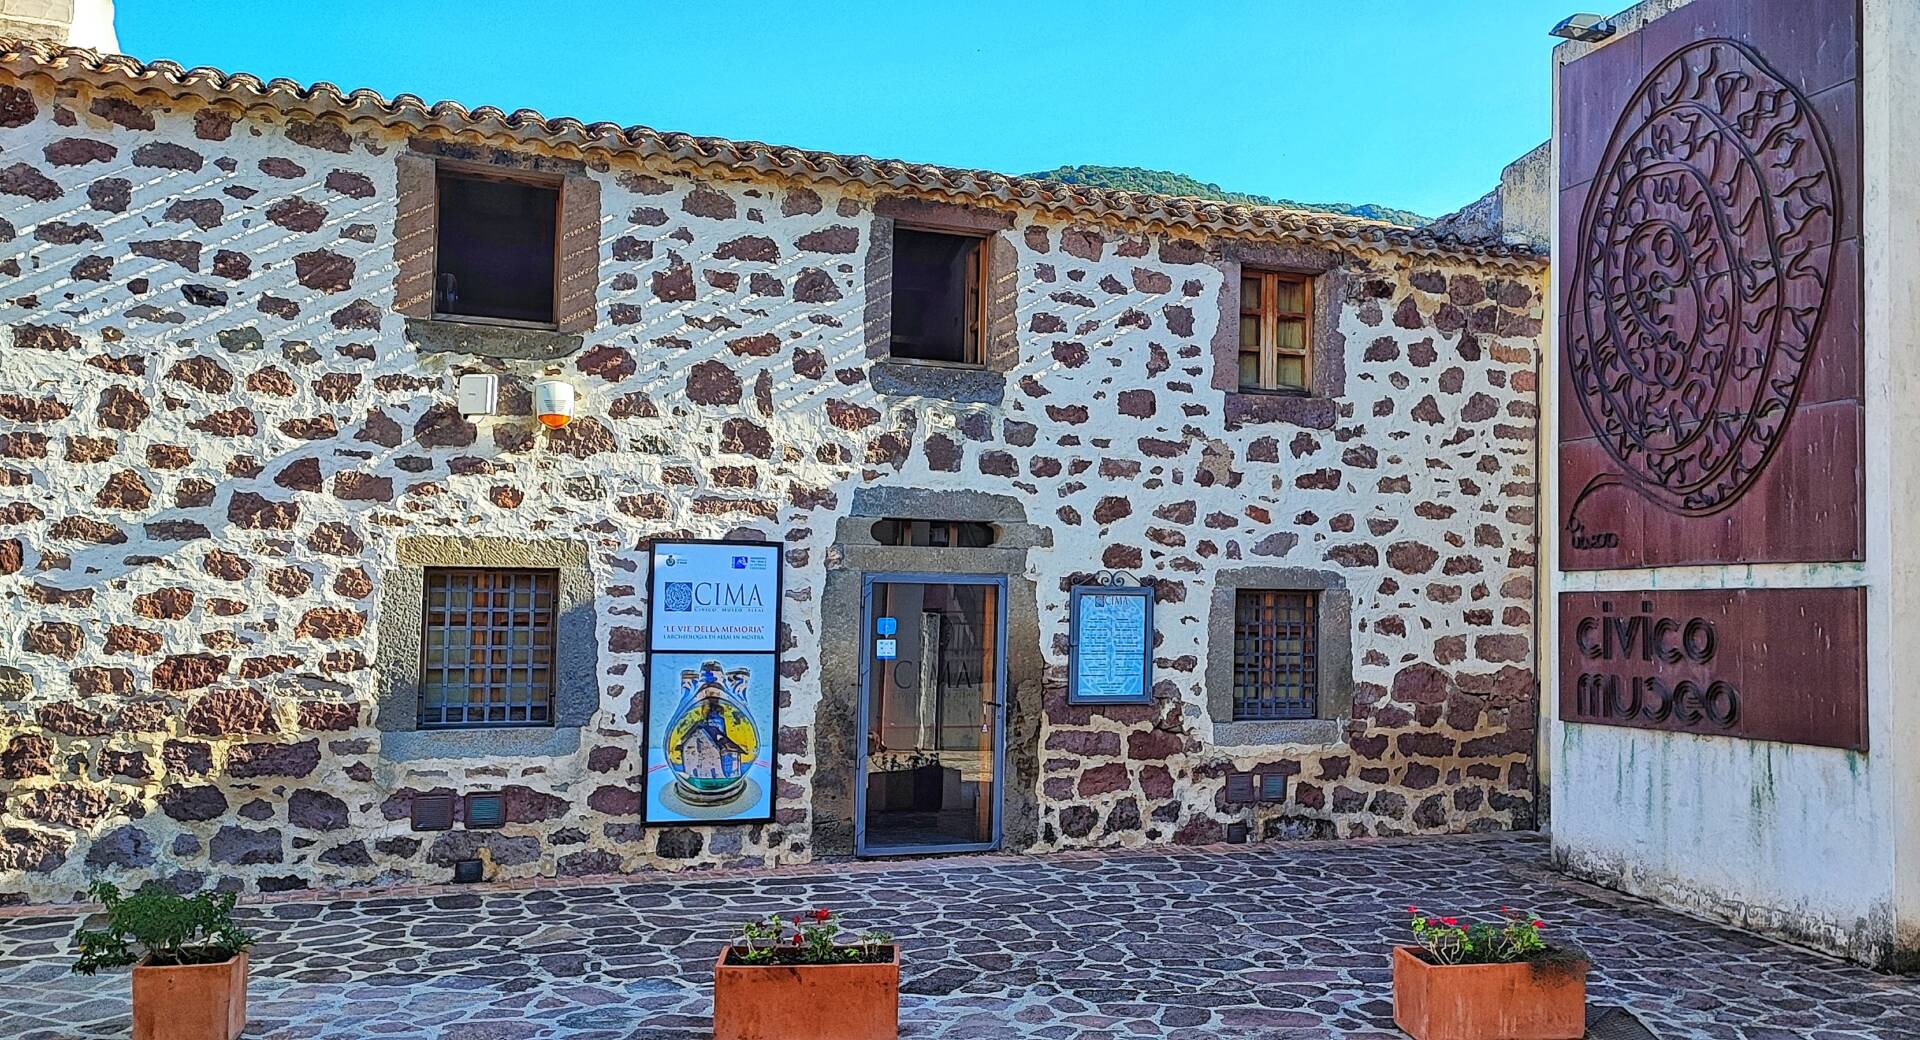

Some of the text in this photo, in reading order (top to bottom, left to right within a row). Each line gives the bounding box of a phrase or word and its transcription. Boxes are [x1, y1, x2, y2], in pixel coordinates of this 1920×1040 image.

[694, 582, 764, 606] CIMA
[677, 625, 692, 633] VIE
[694, 625, 720, 633] DELLA
[721, 625, 765, 634] MEMORIA"
[894, 660, 973, 689] CIMA
